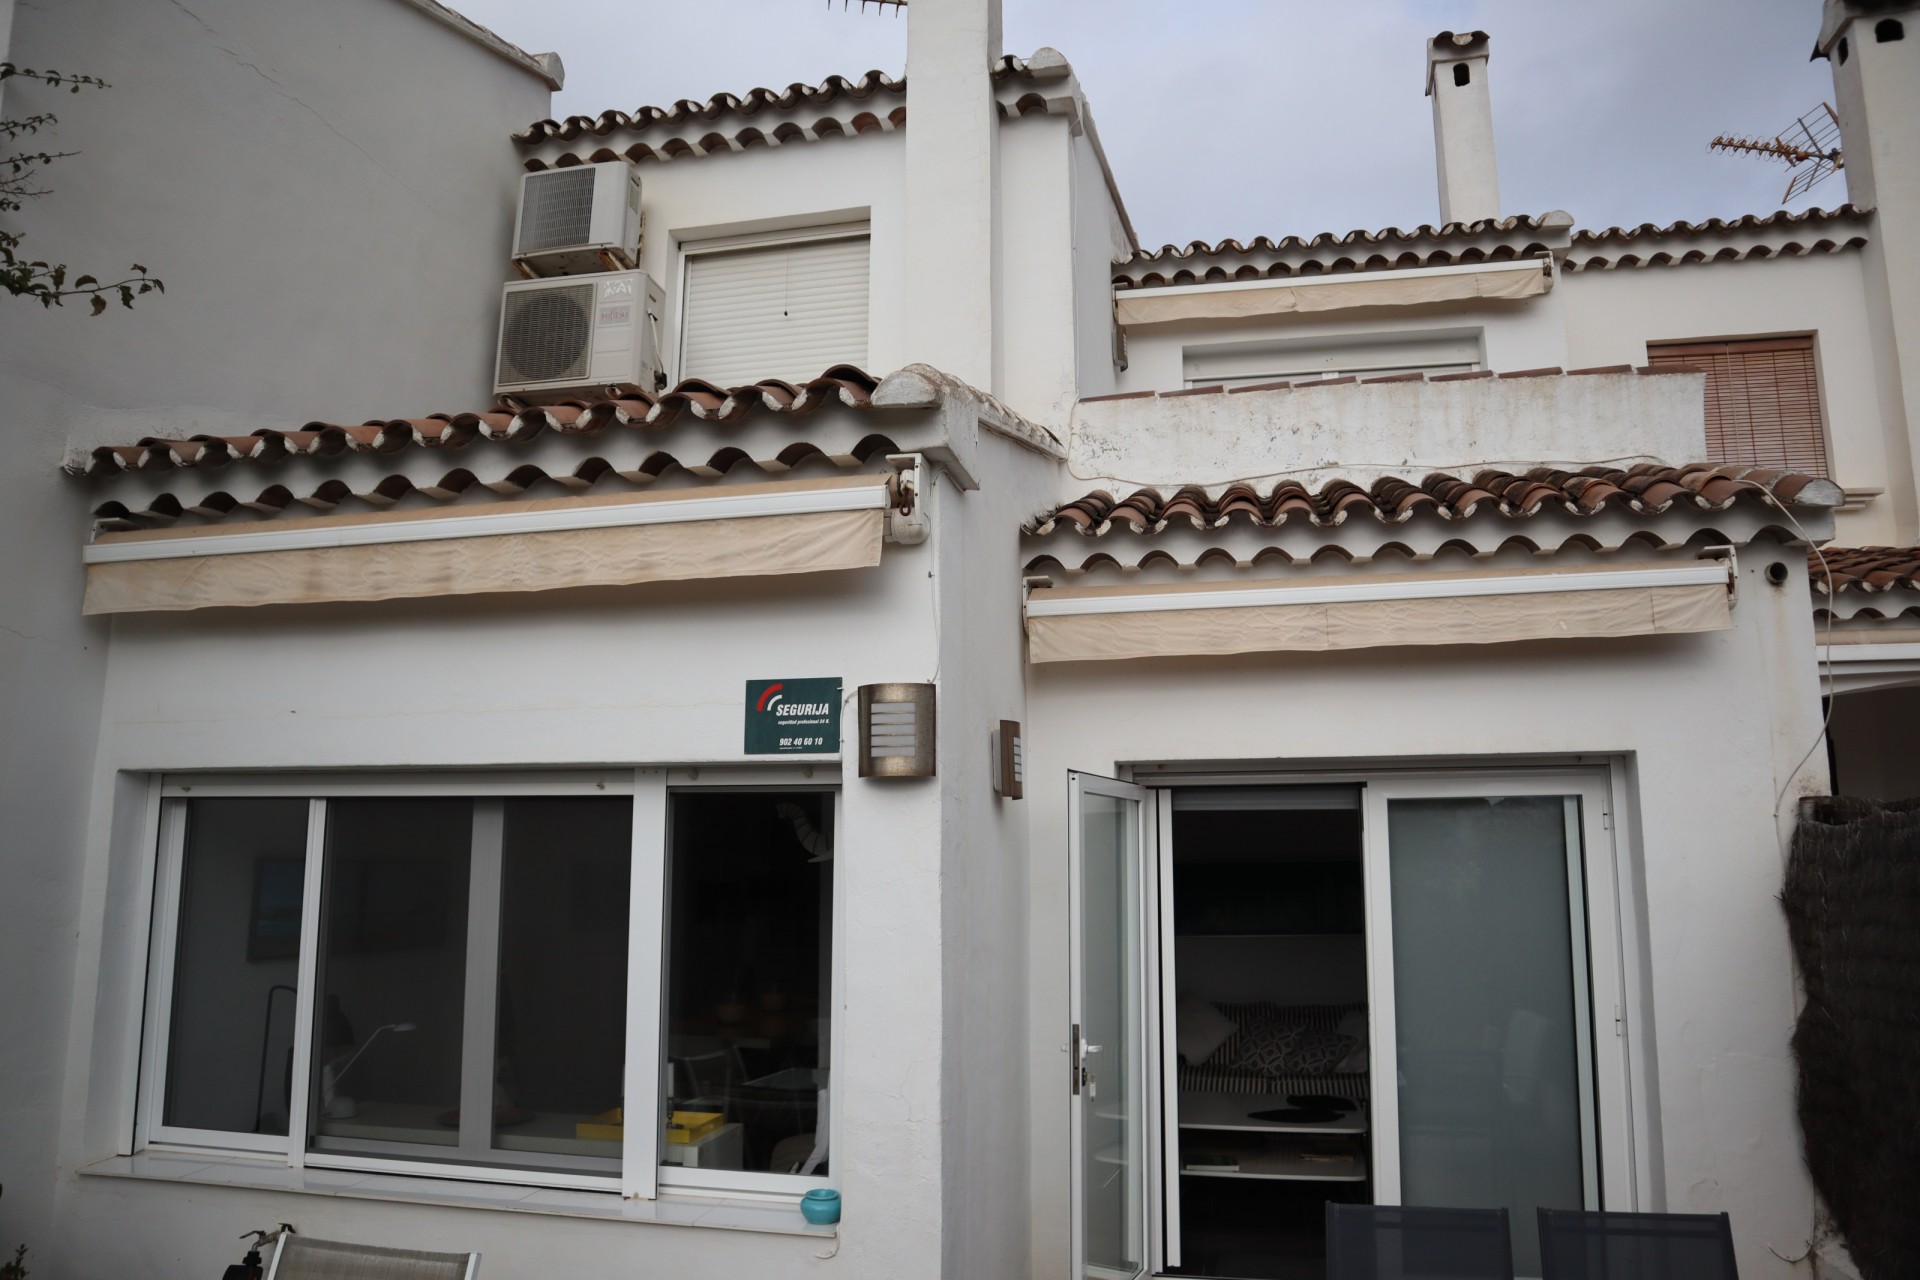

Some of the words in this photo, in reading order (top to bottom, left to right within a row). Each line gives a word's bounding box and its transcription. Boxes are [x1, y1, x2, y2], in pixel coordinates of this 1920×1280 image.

[776, 703, 829, 716] SEGURIJA
[779, 738, 792, 746] 902
[793, 737, 803, 746] 40
[803, 737, 813, 746] 60
[814, 737, 823, 746] 10
